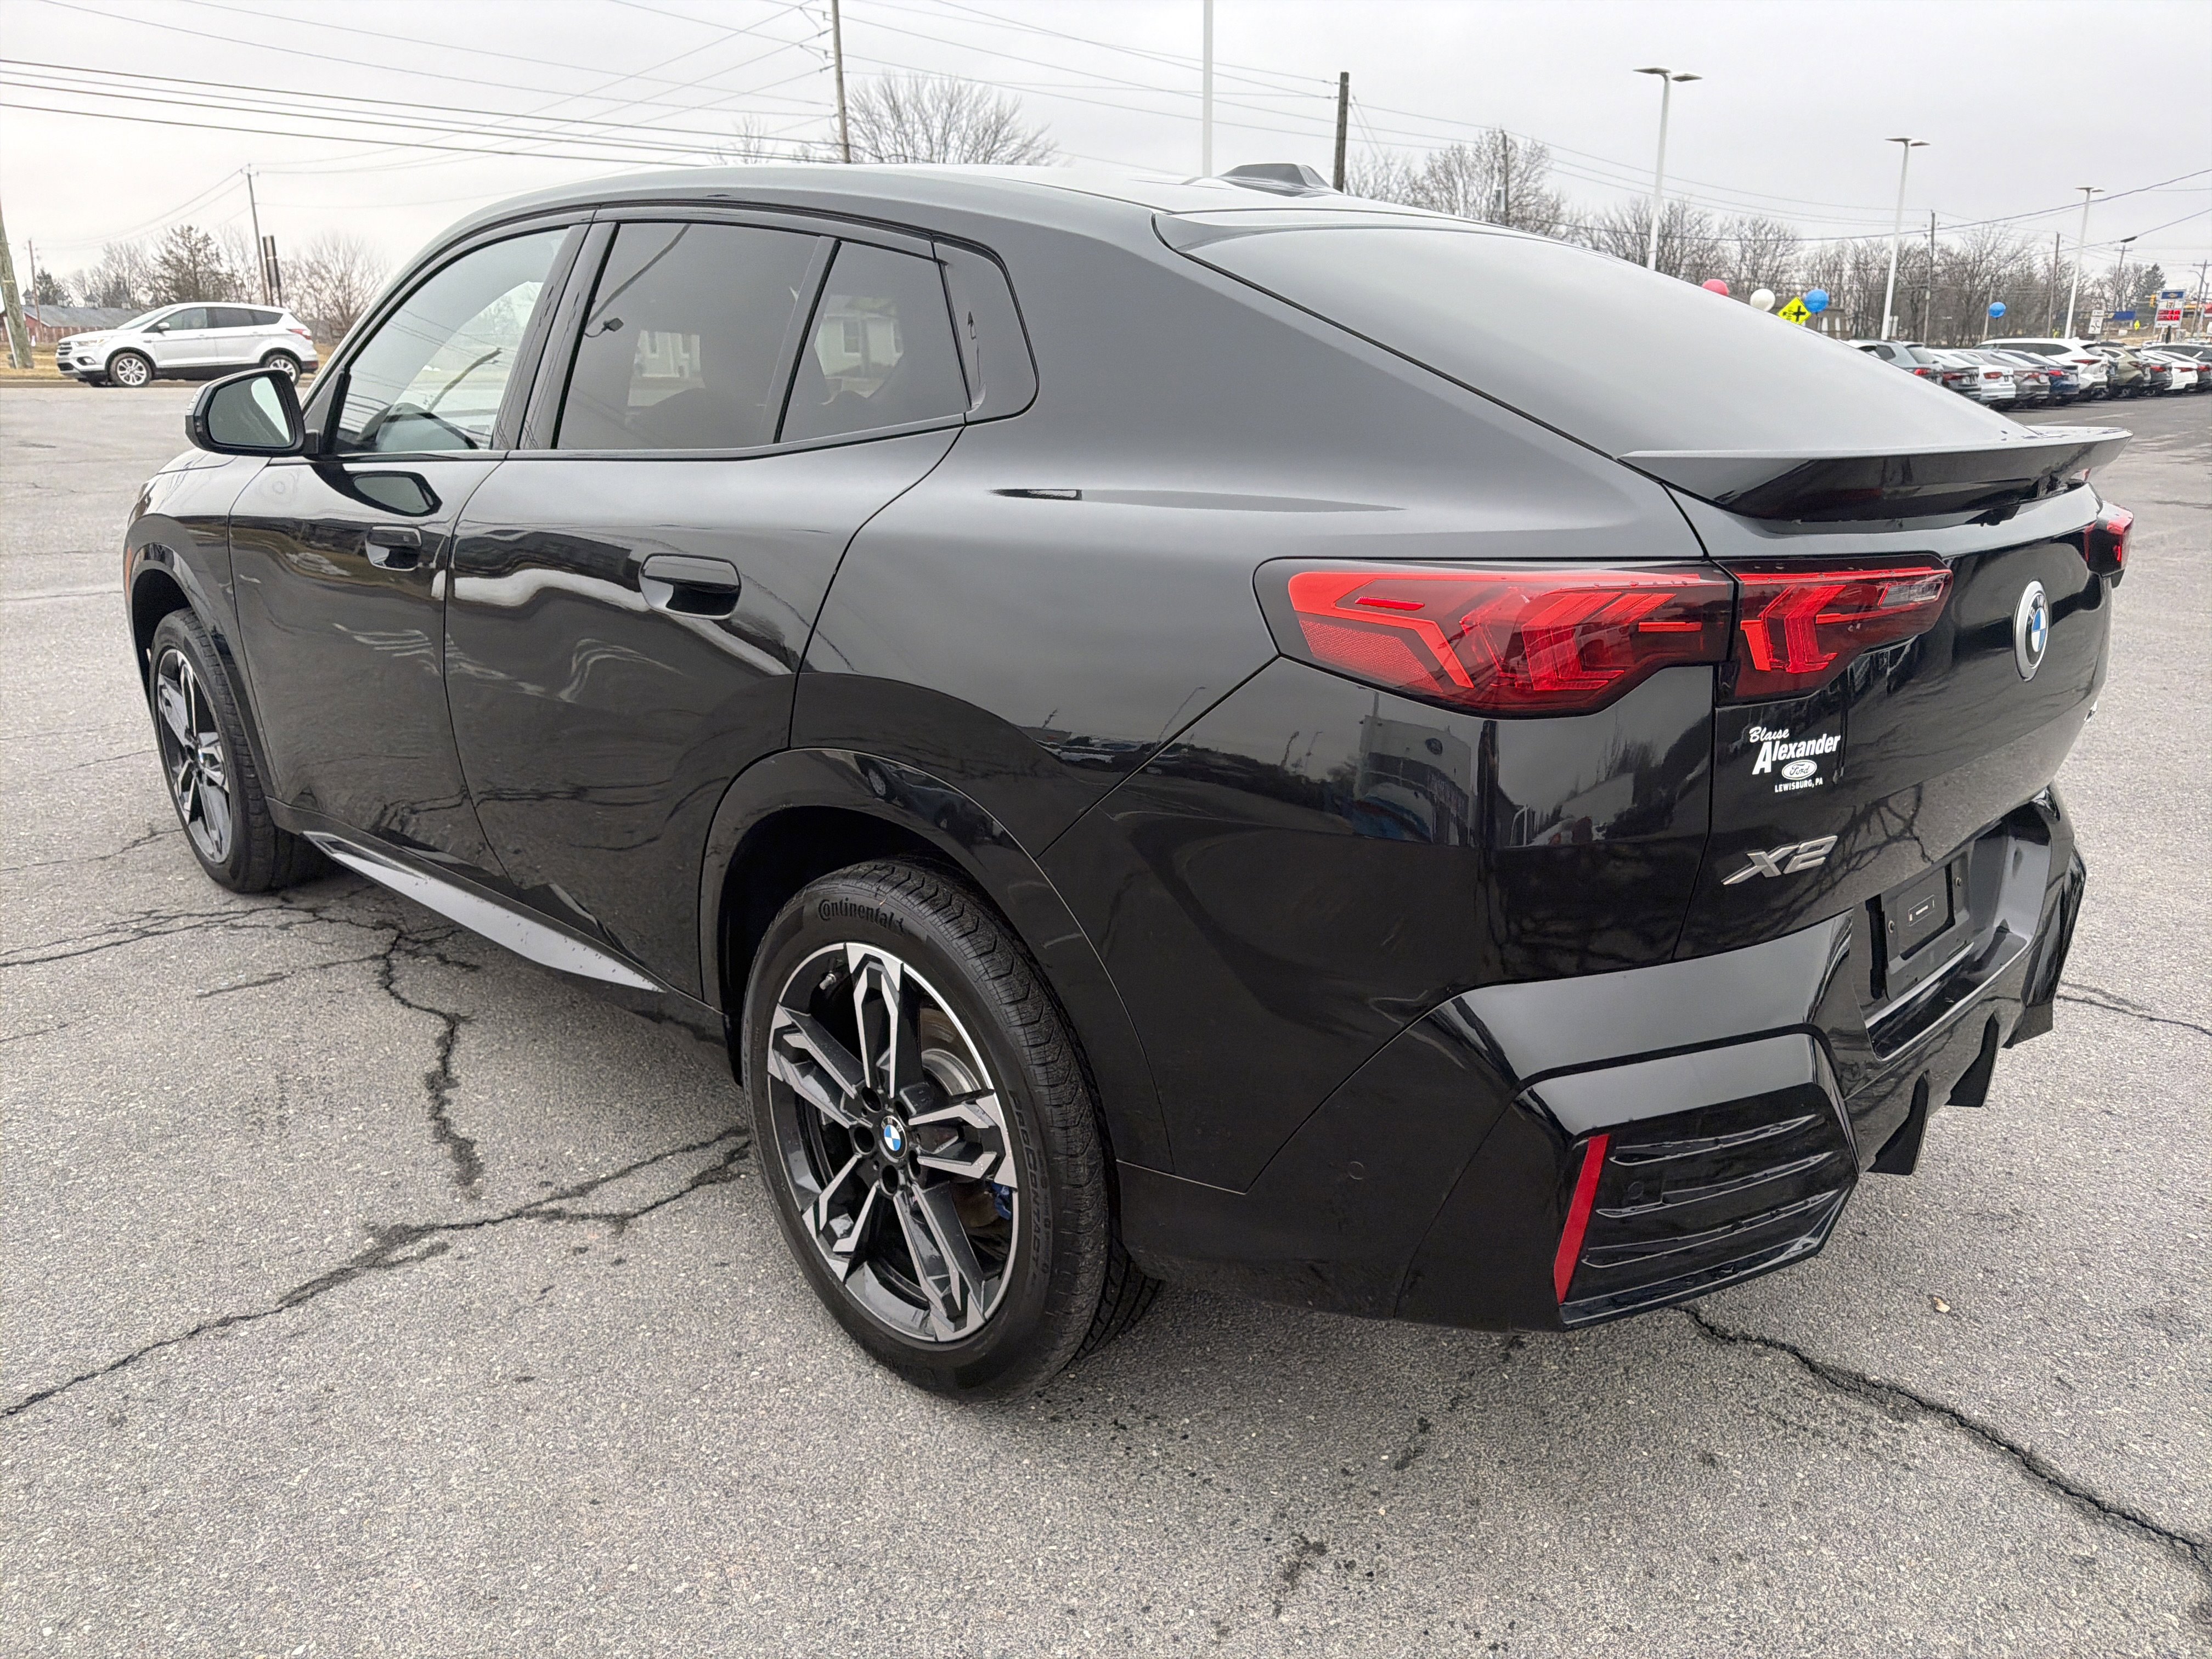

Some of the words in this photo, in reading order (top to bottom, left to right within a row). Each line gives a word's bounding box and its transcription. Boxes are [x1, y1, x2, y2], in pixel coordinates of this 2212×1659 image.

[1749, 726, 1790, 743] Blaise
[1752, 733, 1841, 775] Alexander
[1789, 763, 1810, 776] Ford
[1775, 780, 1814, 793] LEWISBURG,
[1815, 777, 1823, 786] PA
[1721, 834, 1838, 885] X2
[818, 897, 895, 928] Continental
[881, 1117, 902, 1132] BMW
